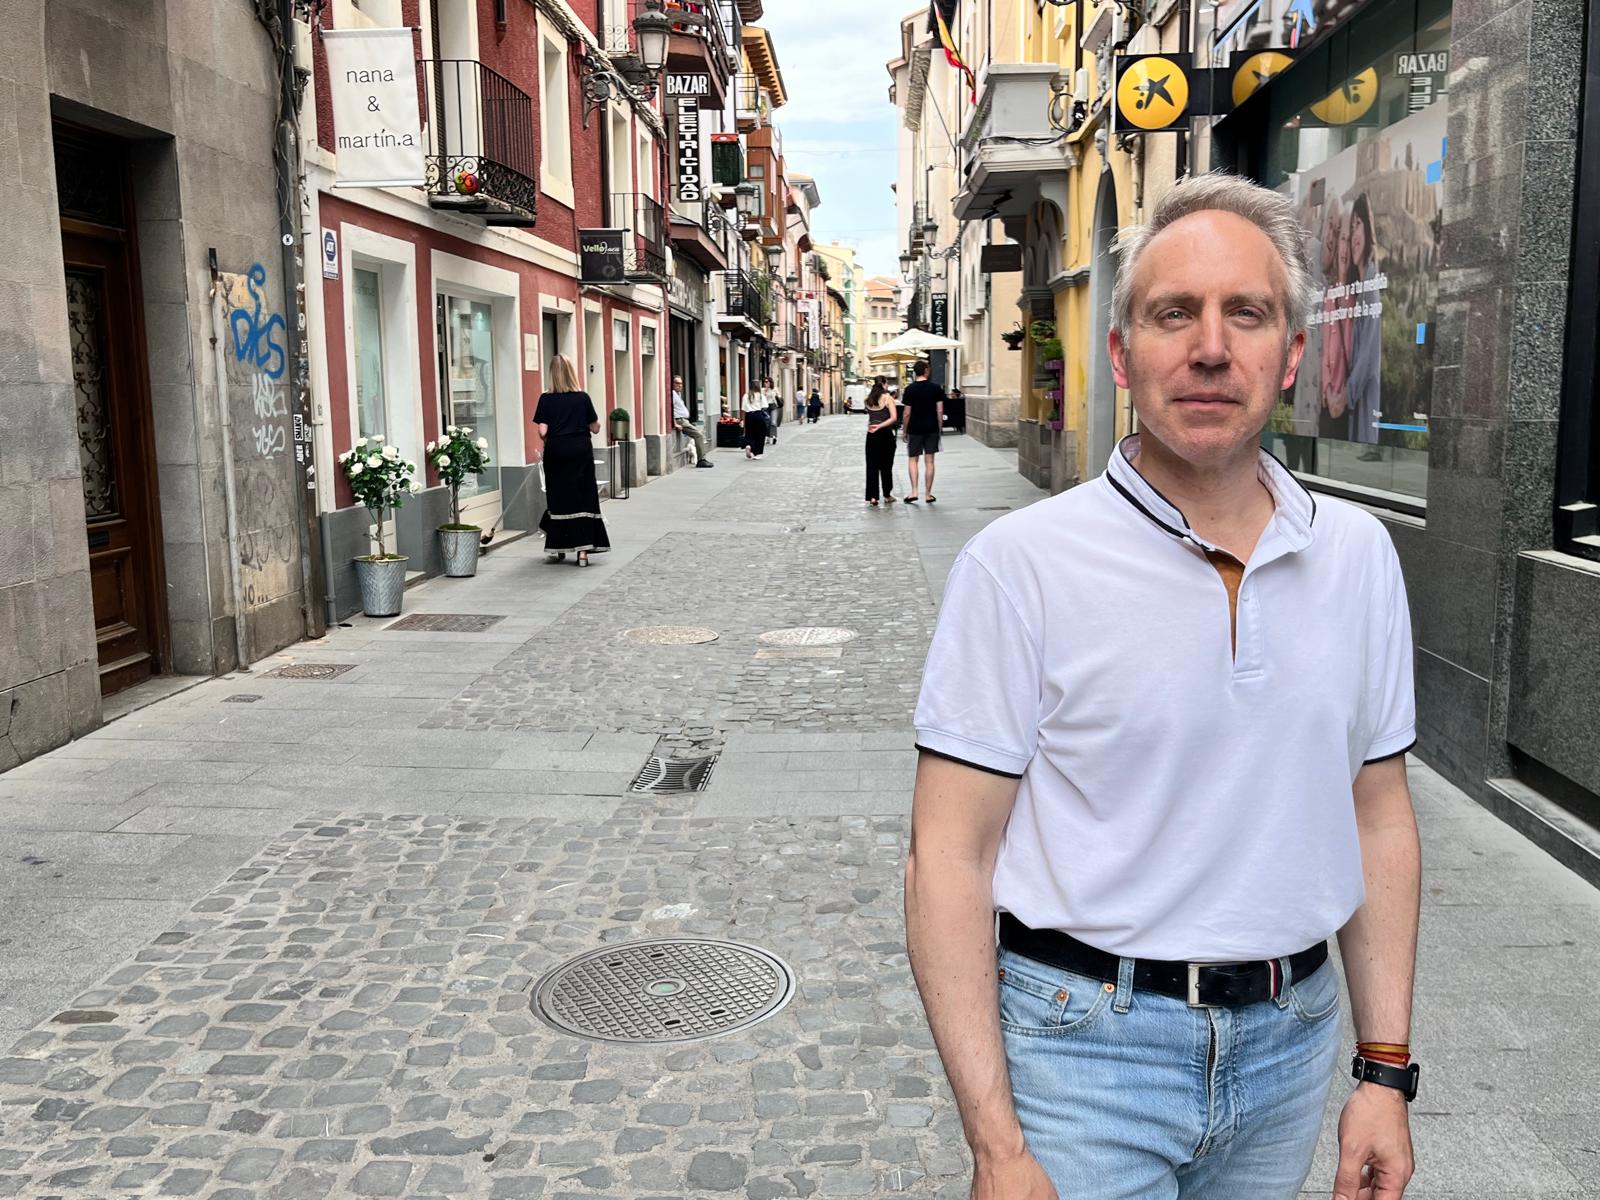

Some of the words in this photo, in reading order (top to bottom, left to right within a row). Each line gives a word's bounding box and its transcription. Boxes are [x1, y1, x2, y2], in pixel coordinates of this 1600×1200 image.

[346, 69, 395, 83] nana
[666, 75, 708, 94] BAZAR
[367, 95, 381, 112] &
[338, 128, 415, 149] martín.a
[678, 98, 699, 201] ELECTRICIDAD
